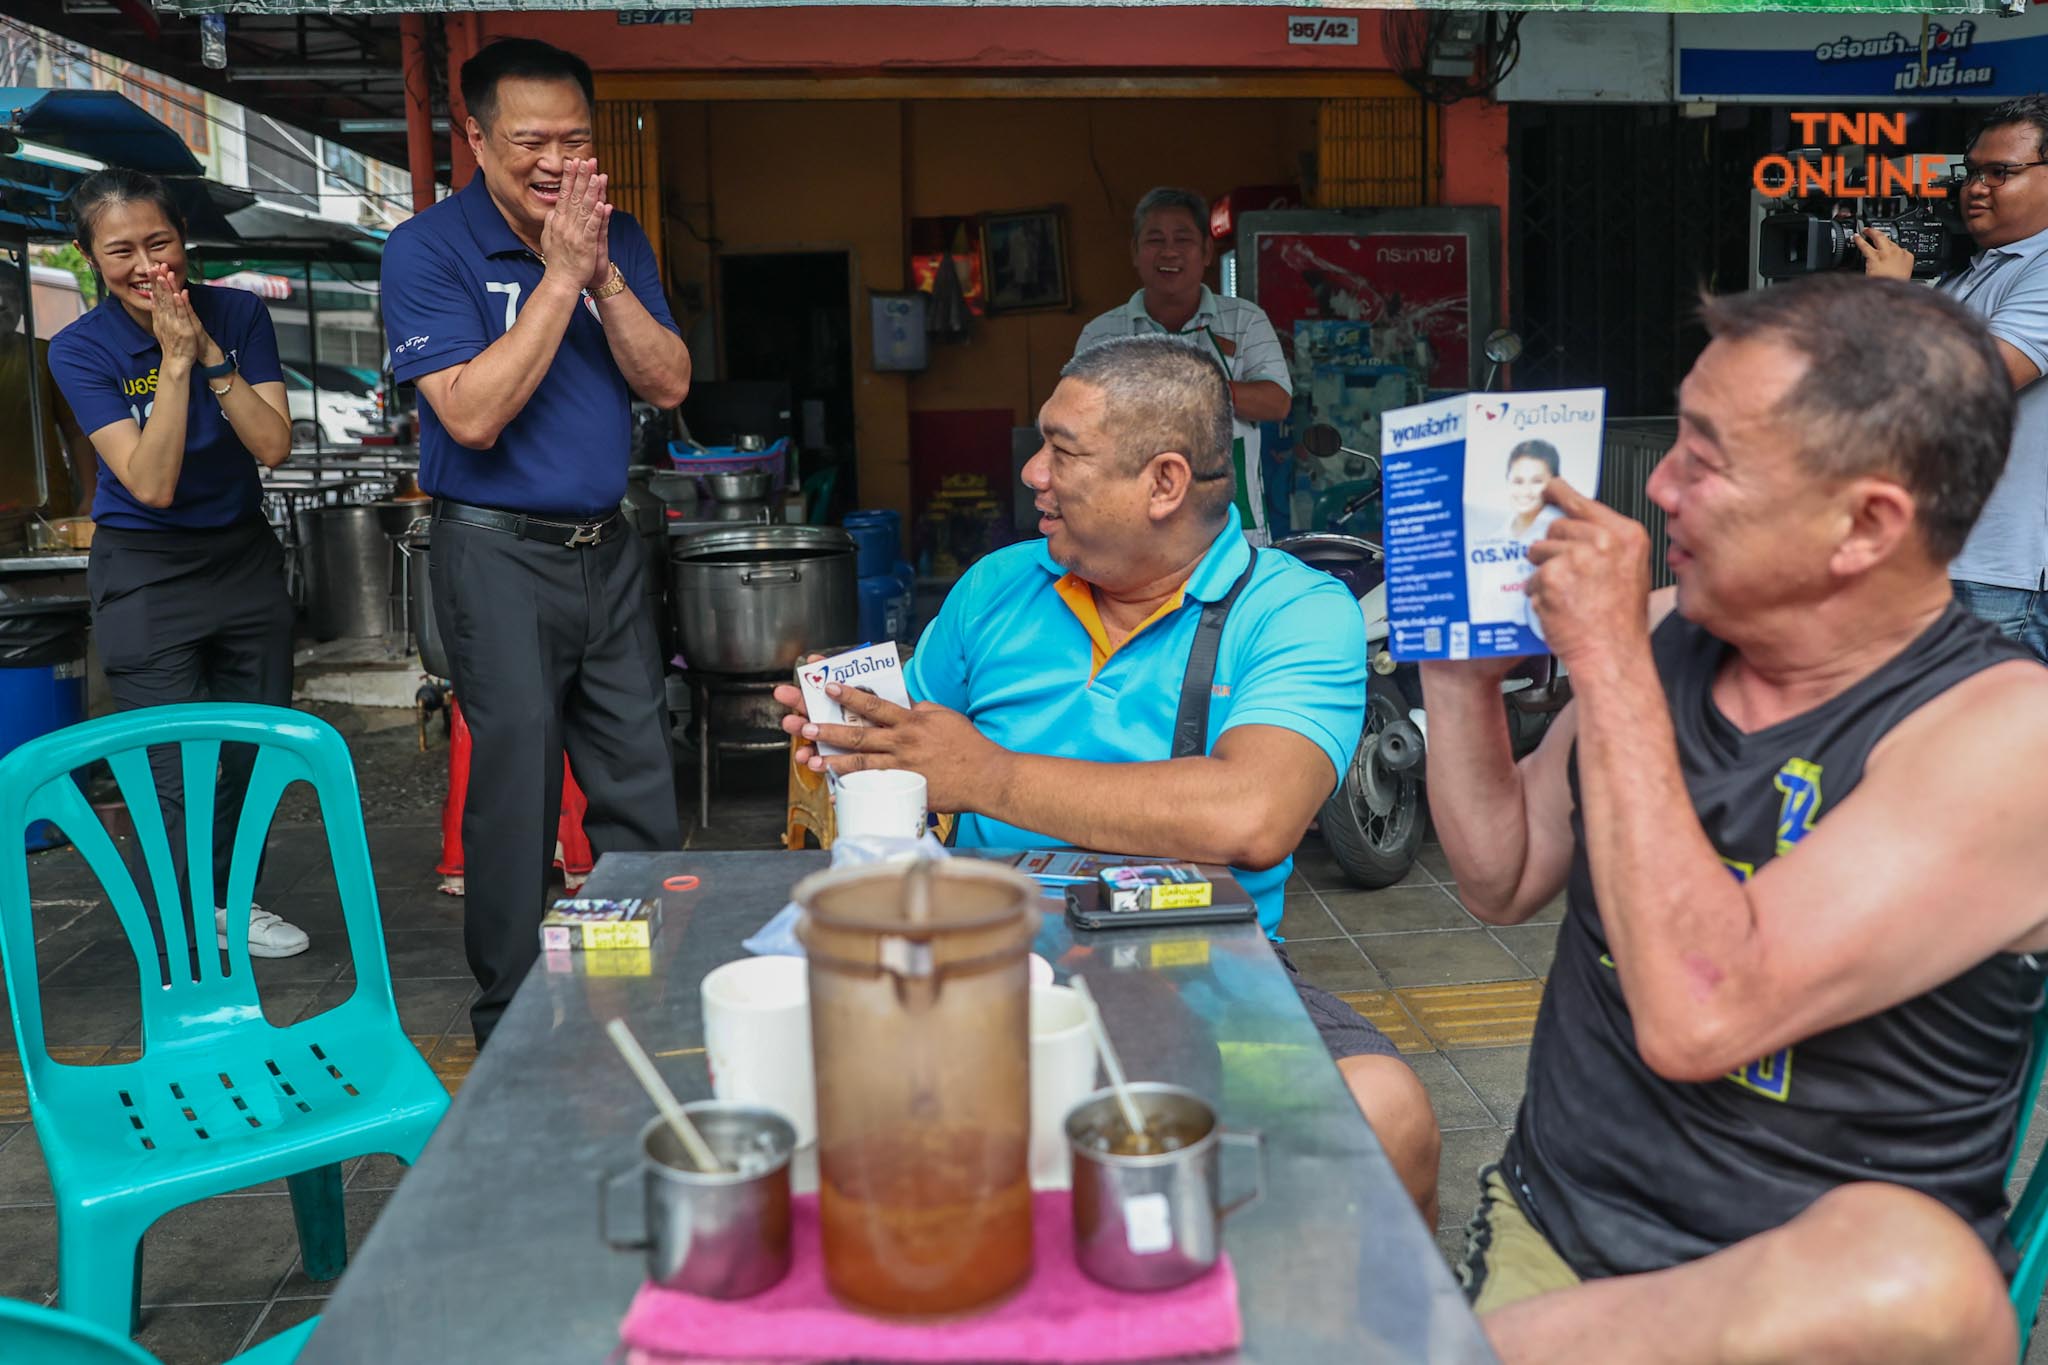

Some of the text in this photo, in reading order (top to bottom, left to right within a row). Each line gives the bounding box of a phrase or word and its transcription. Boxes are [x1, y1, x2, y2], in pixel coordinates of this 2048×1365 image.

[1292, 20, 1349, 41] 95/42
[1513, 403, 1596, 431] ภูมิใจไทย
[834, 656, 896, 684] ภูมิใจไทย
